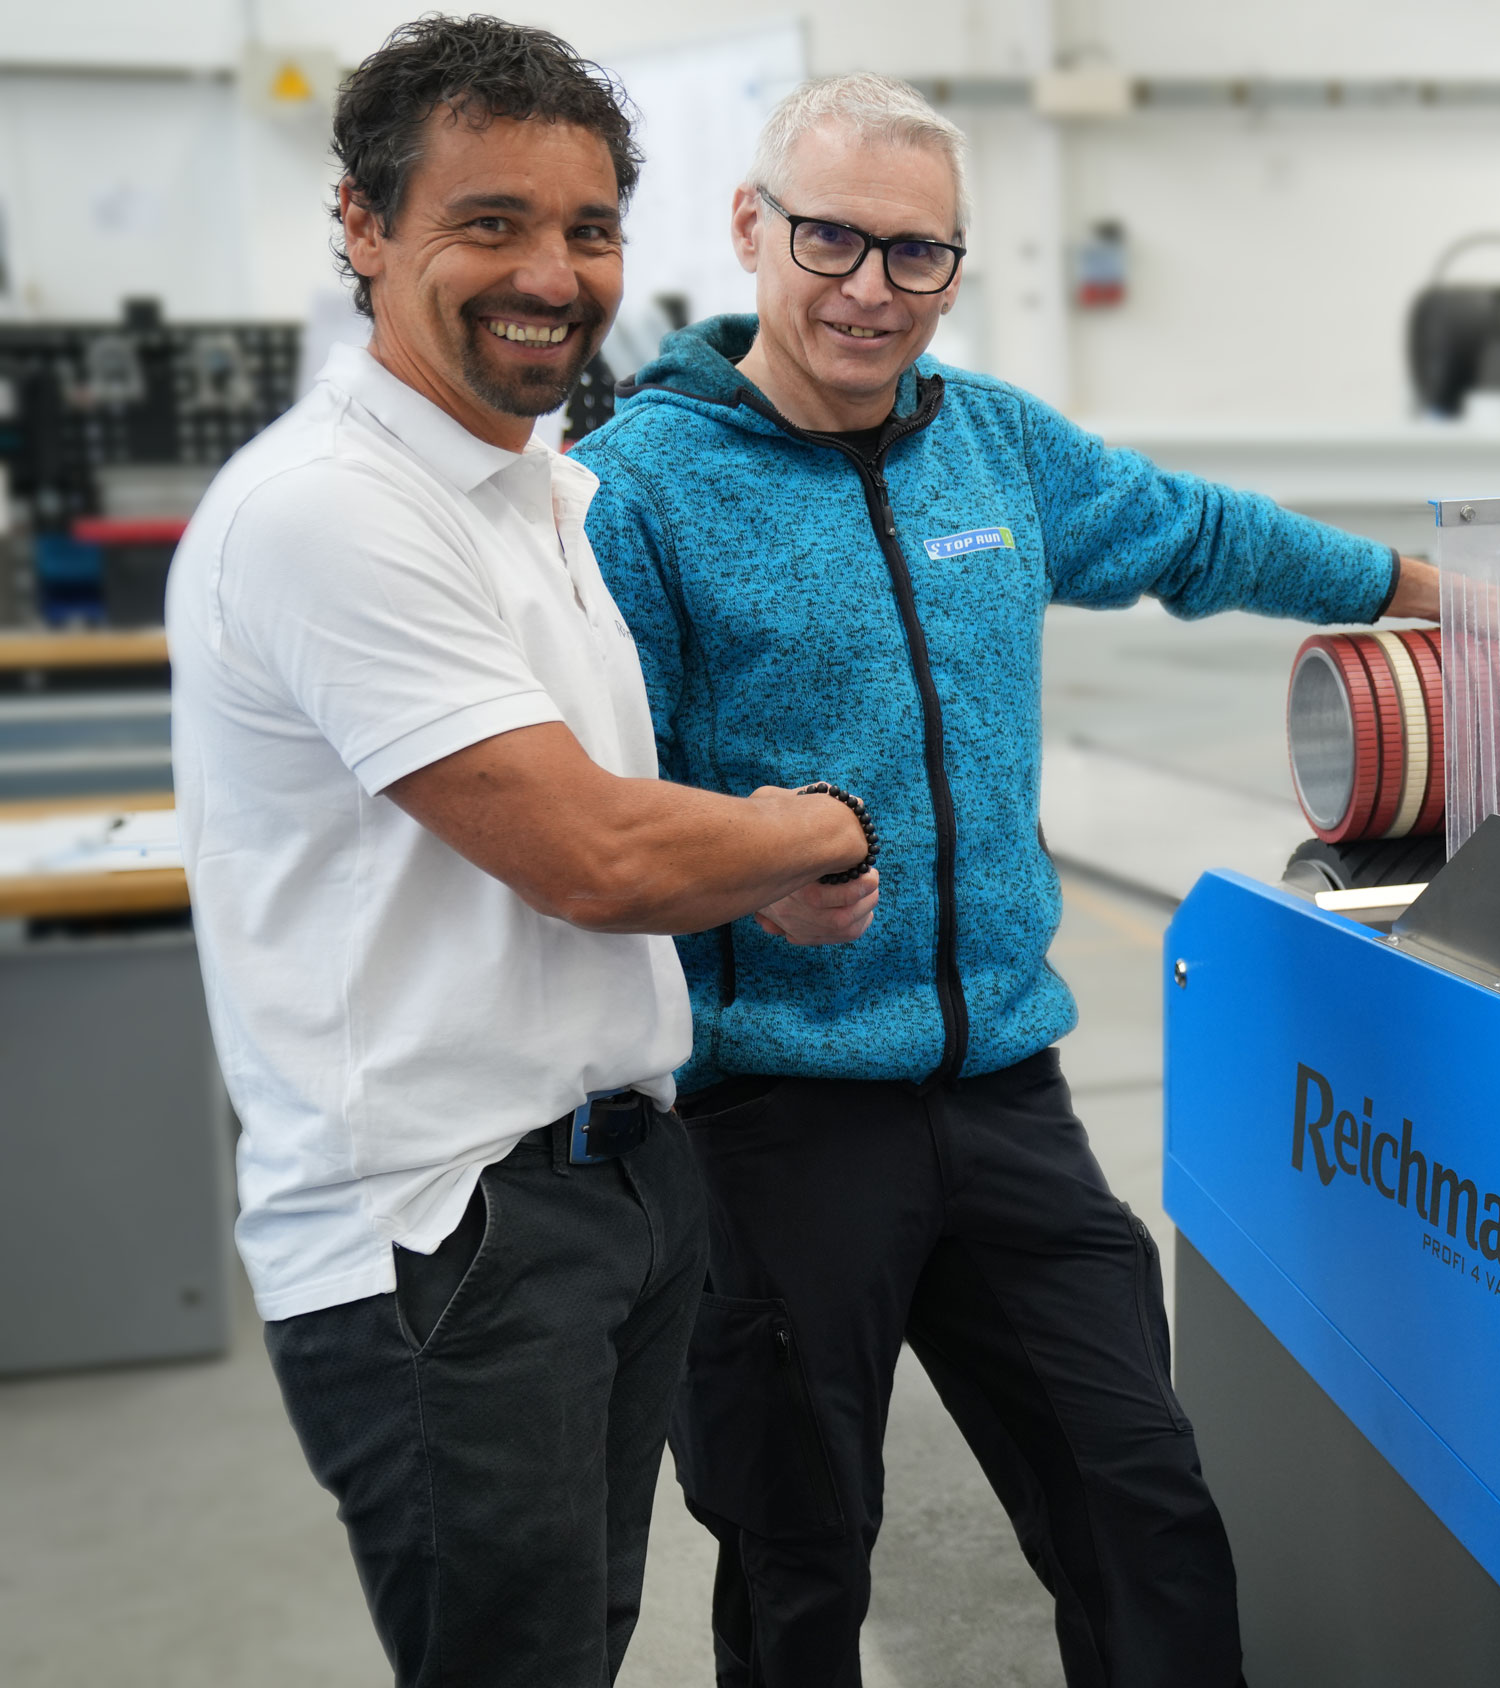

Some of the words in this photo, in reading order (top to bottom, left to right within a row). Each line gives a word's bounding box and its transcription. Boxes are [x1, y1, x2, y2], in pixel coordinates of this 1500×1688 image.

[944, 538, 973, 552] TOP
[976, 533, 1000, 544] RUN
[1422, 1232, 1465, 1274] PROFI
[1471, 1265, 1480, 1284] 4
